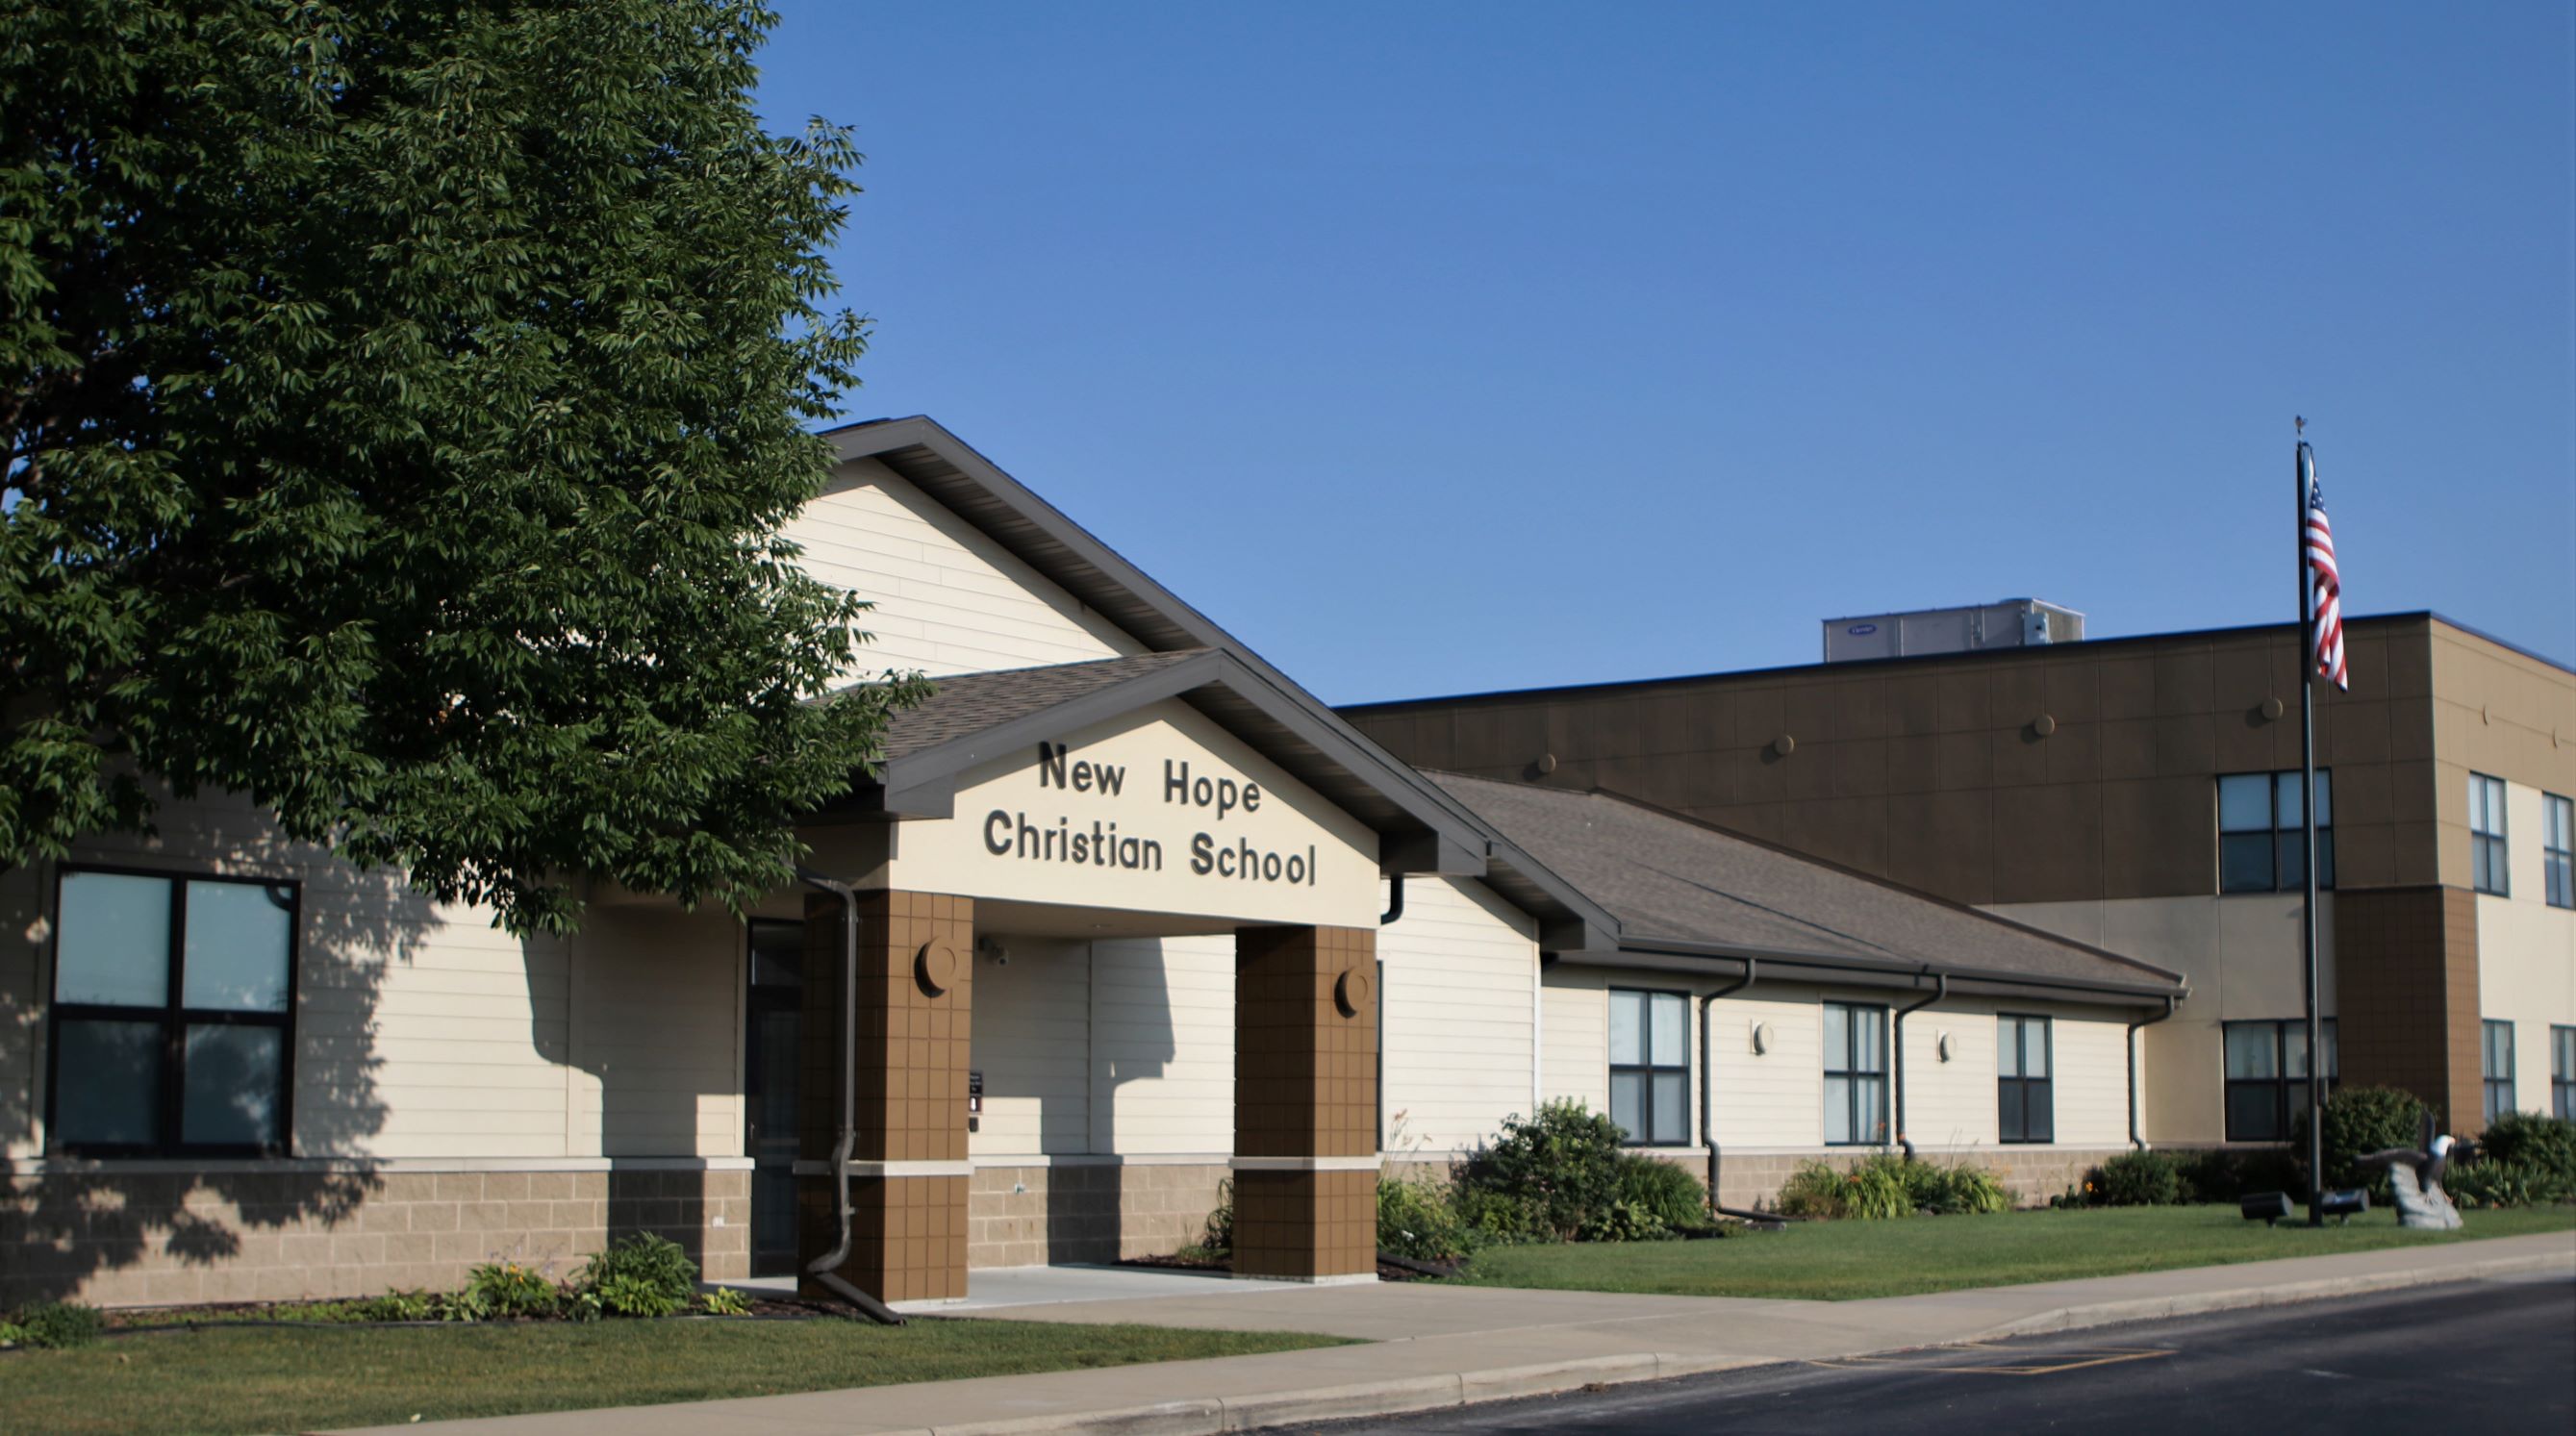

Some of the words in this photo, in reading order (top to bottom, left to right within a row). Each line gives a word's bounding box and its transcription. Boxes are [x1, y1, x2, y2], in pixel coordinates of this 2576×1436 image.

[1039, 741, 1125, 796] New
[1164, 759, 1261, 820] Hope
[983, 809, 1162, 870] Christian
[1191, 832, 1316, 886] School
